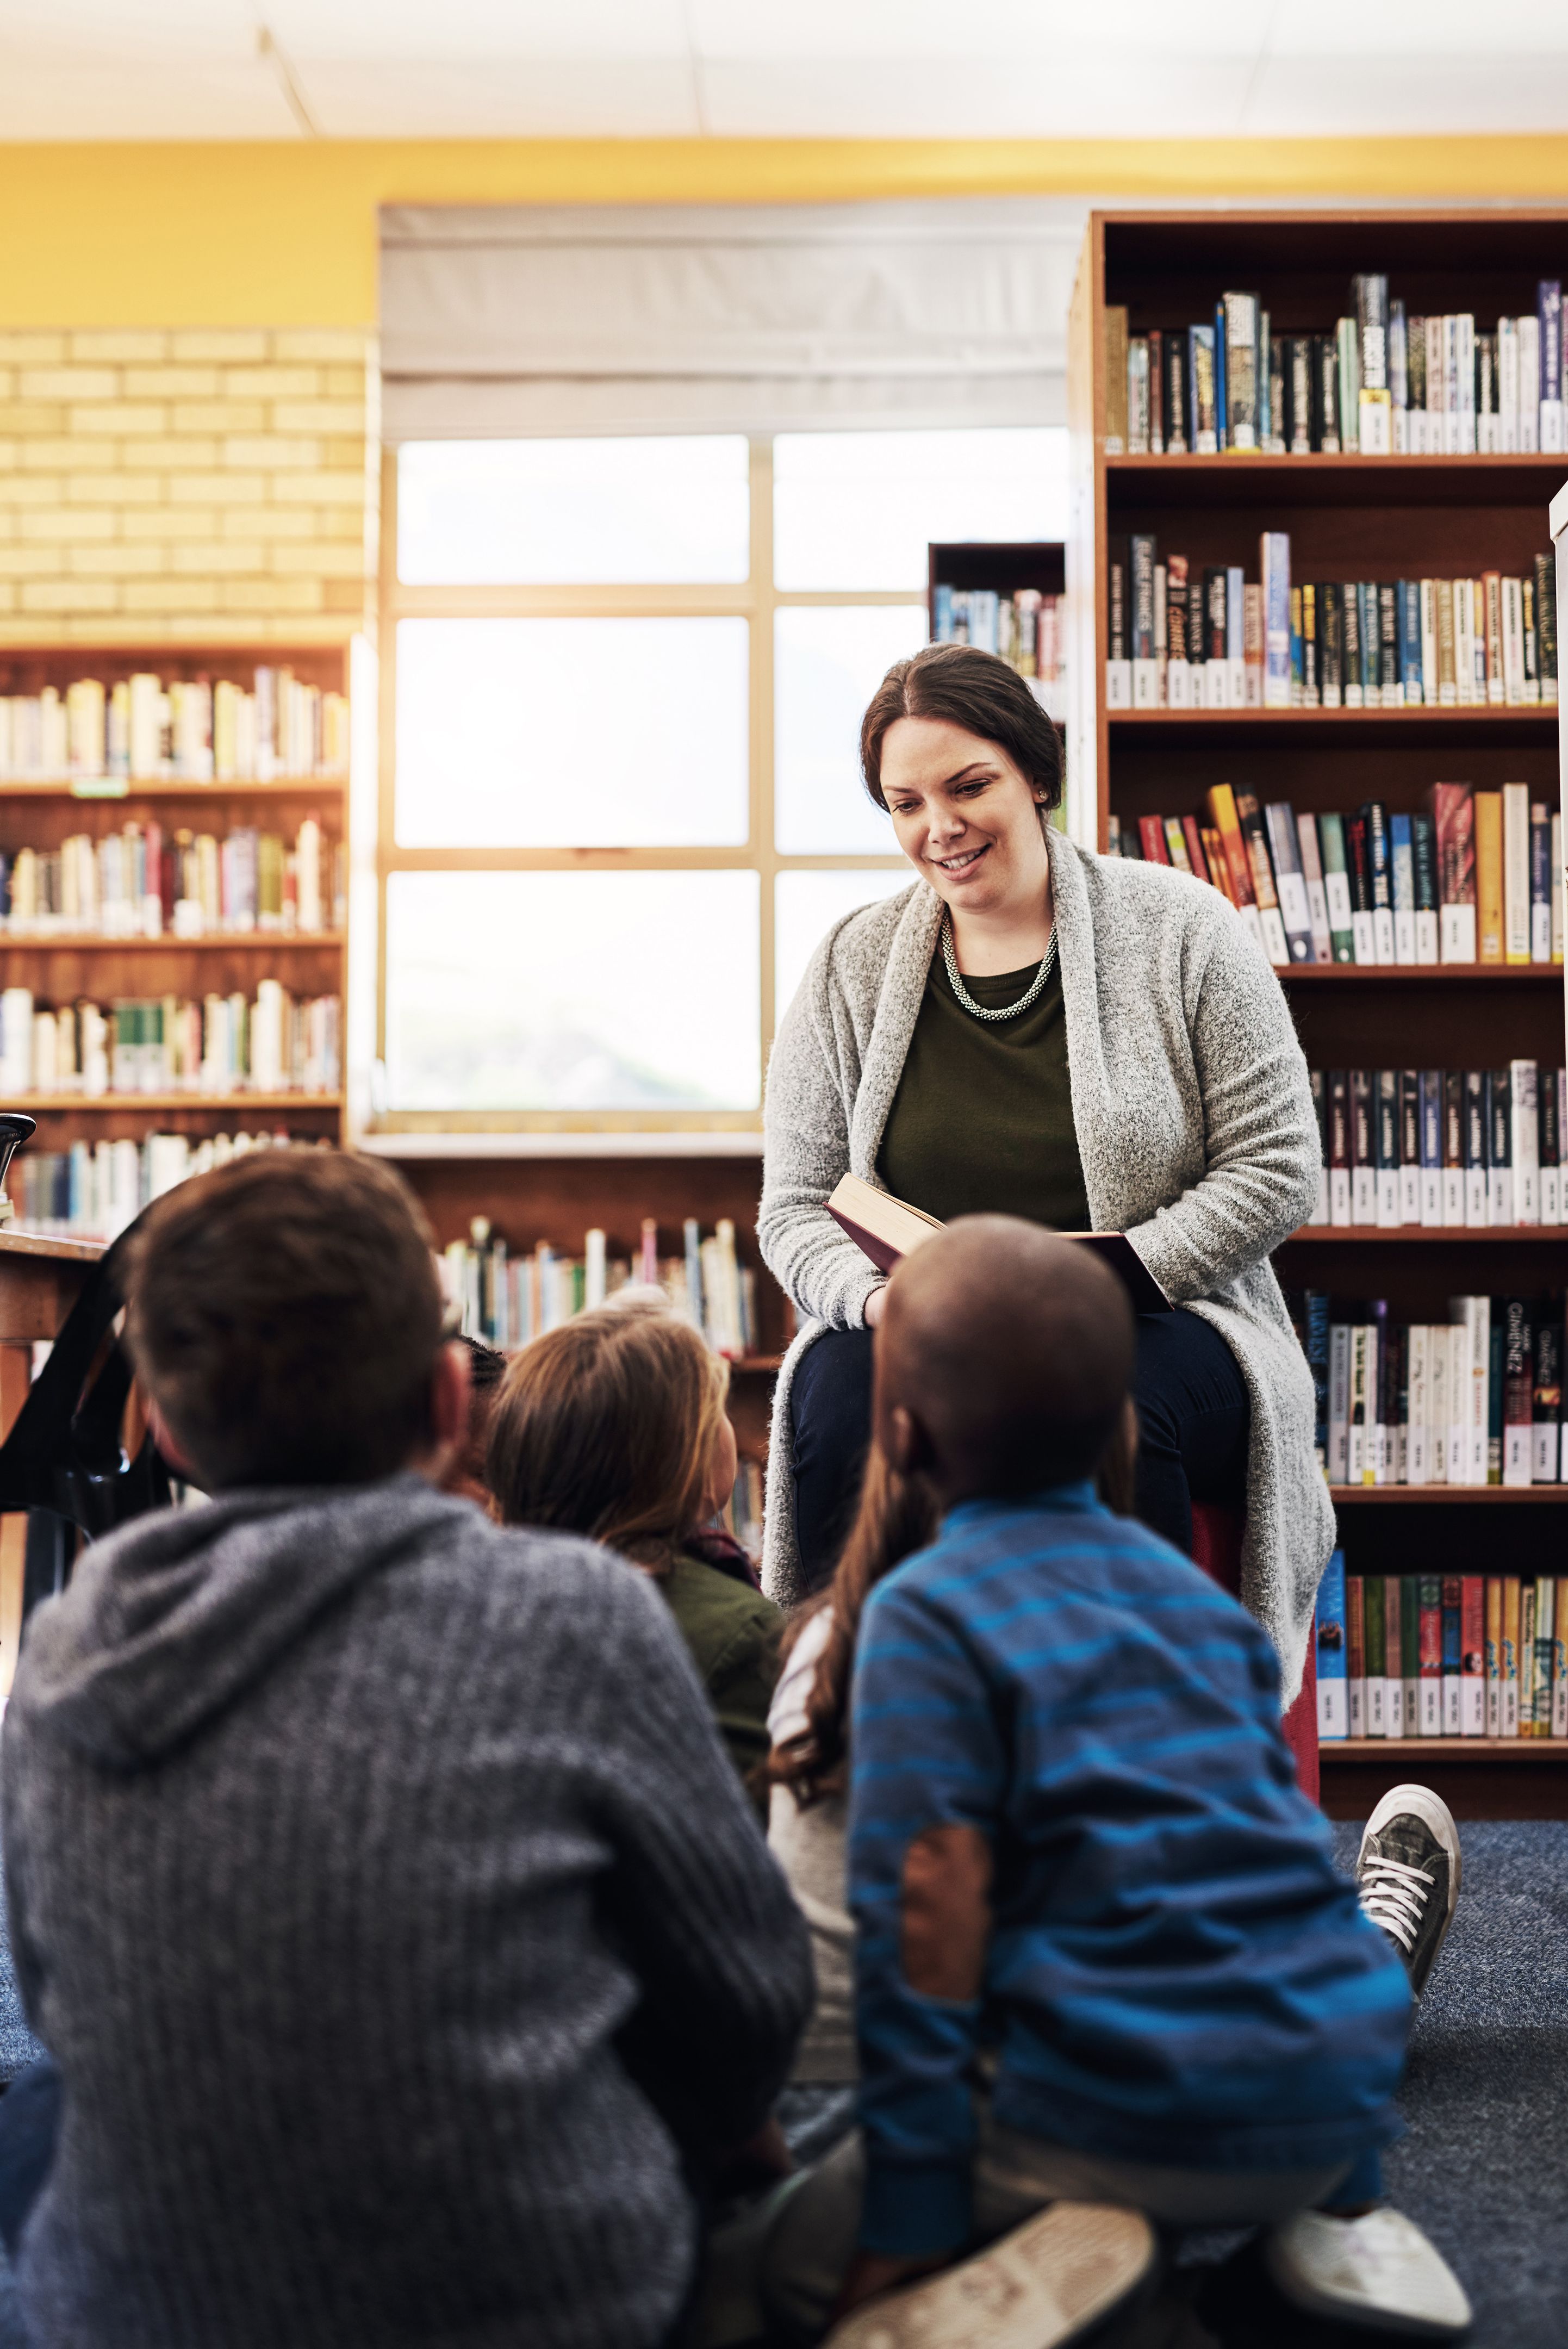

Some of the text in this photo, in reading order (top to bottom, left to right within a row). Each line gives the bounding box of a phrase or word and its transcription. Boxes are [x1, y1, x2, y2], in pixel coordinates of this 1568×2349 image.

[1137, 541, 1153, 631] CLARE FRANCIS
[1191, 610, 1203, 654] FRANCIS
[1346, 610, 1358, 652] FRANCIS
[1507, 1302, 1523, 1374] GIMENEZ
[1523, 1323, 1532, 1352] MARK
[1538, 1330, 1552, 1384] GIMENEZ
